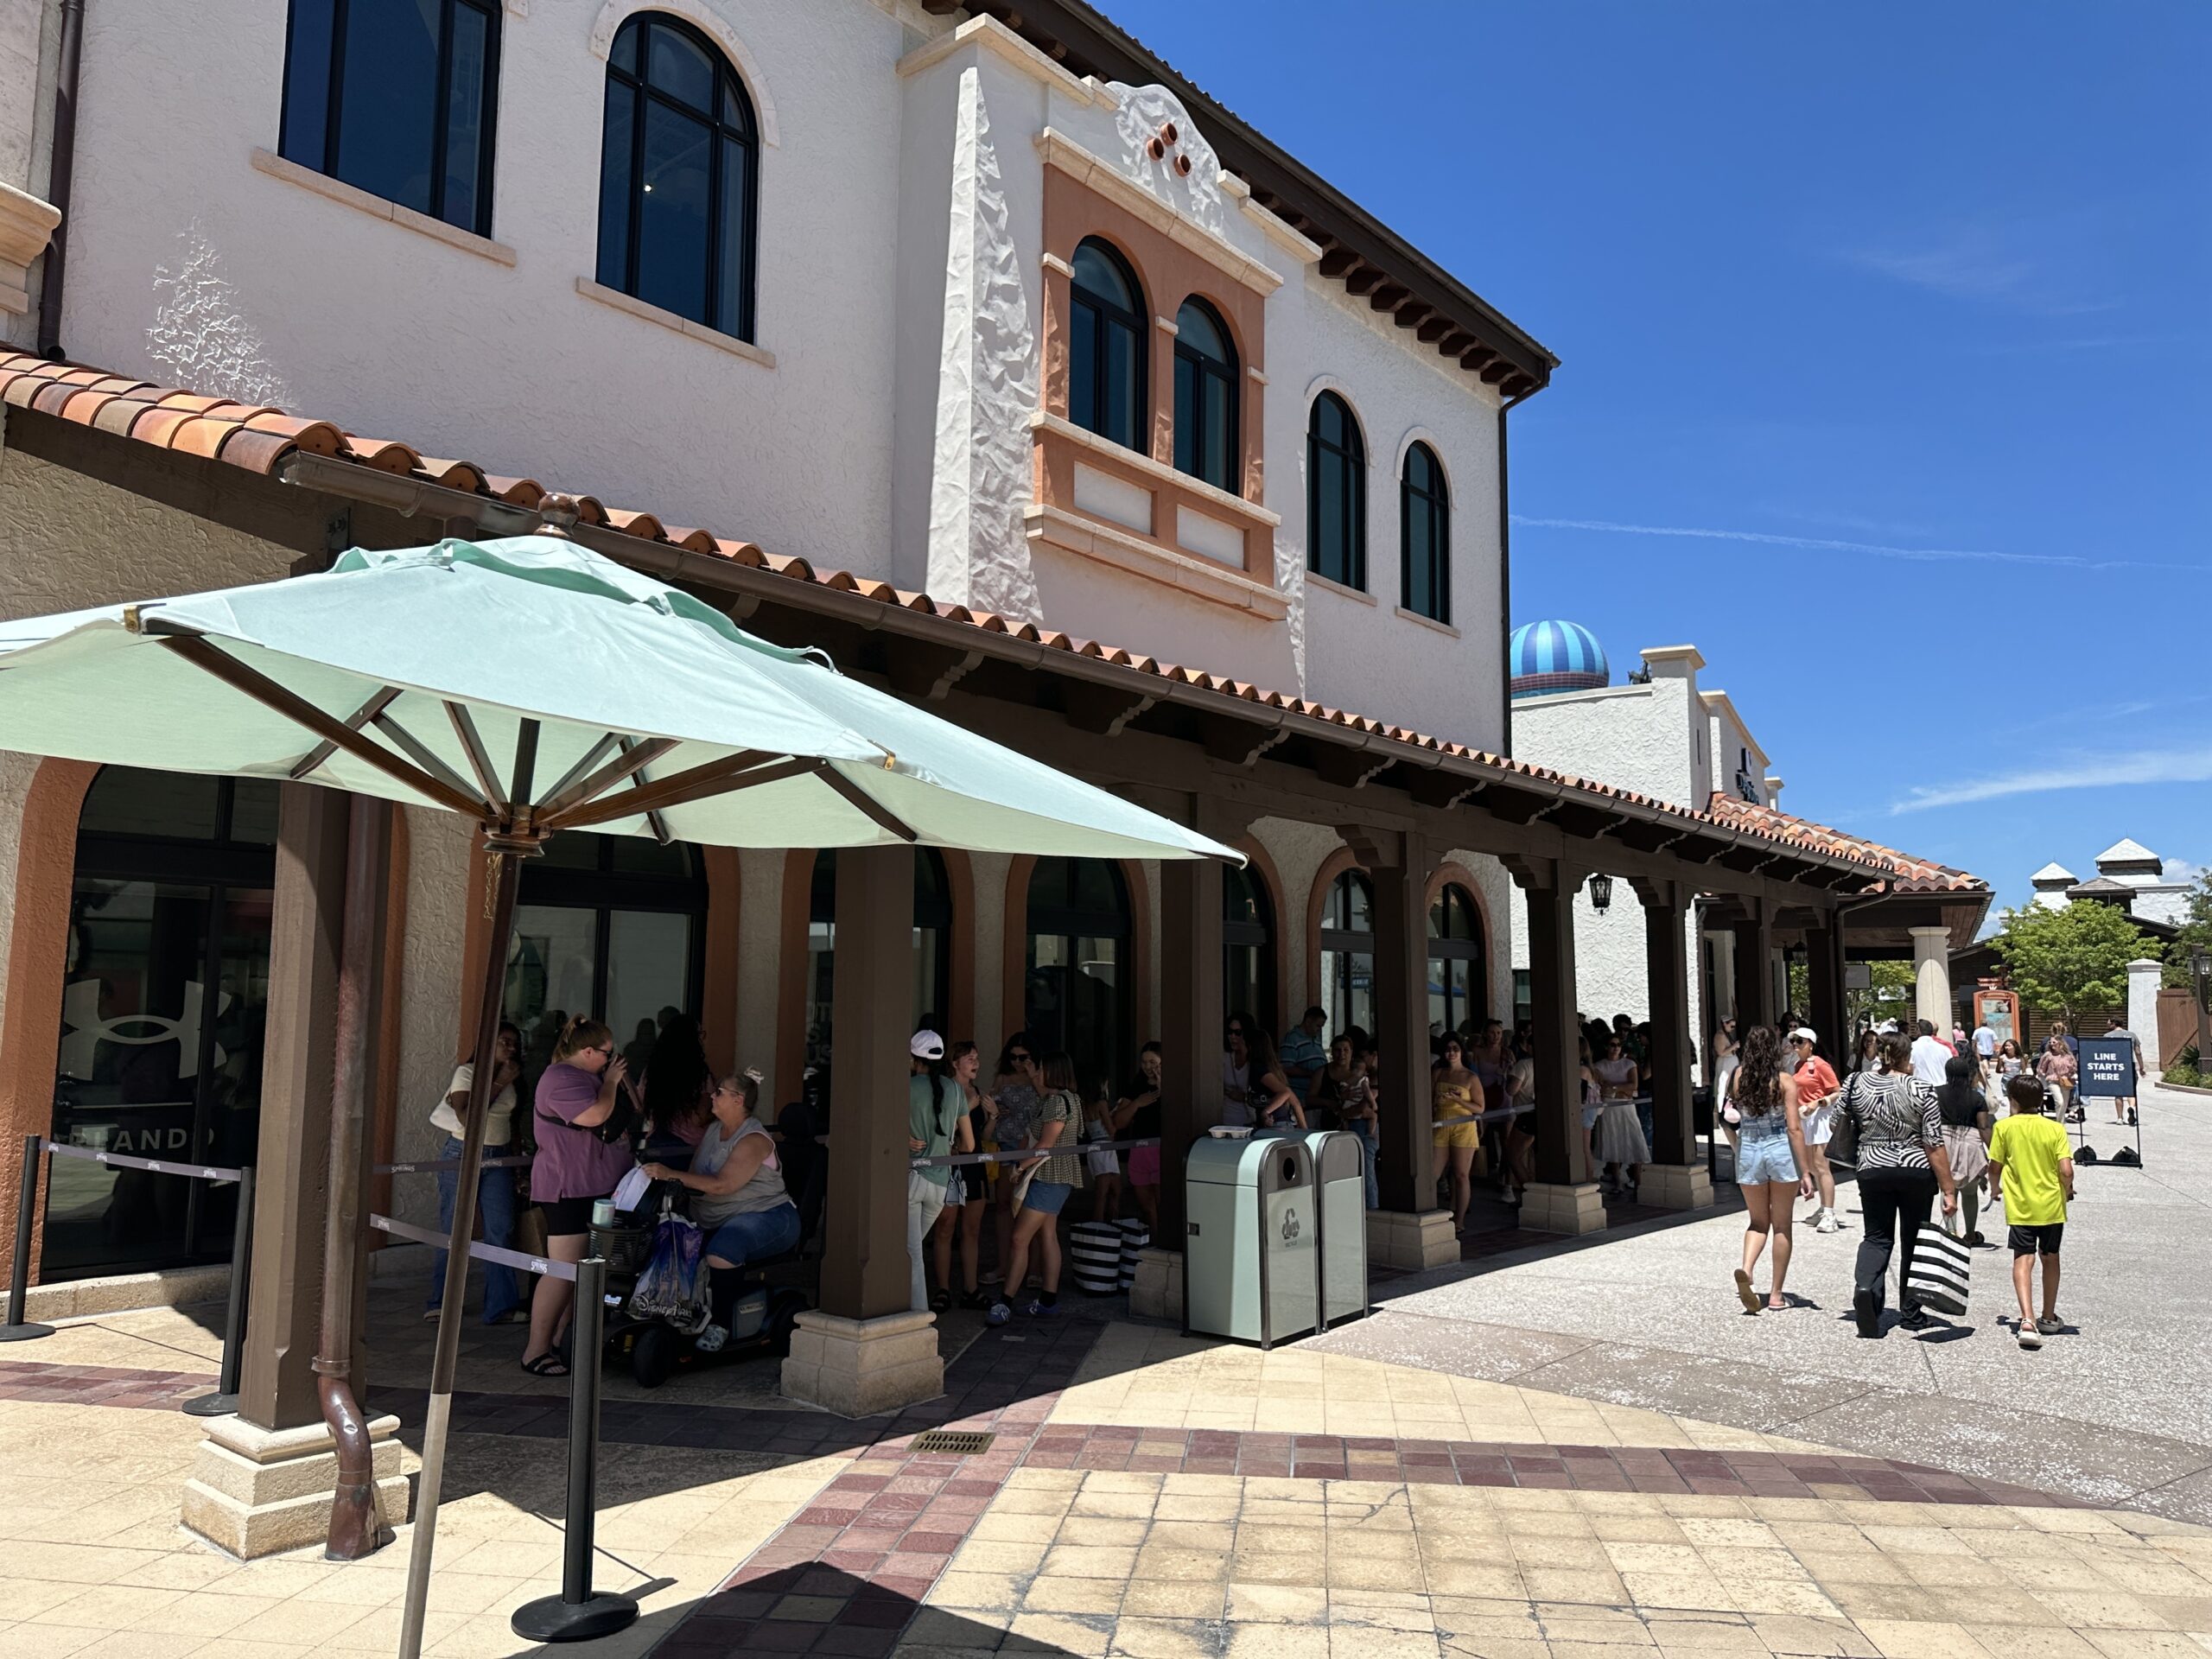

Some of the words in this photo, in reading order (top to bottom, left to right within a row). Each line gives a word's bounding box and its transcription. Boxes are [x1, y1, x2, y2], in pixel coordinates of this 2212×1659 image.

[2094, 1052, 2117, 1061] LINE
[2087, 1062, 2126, 1071] STARTS
[2093, 1072, 2120, 1081] HERE
